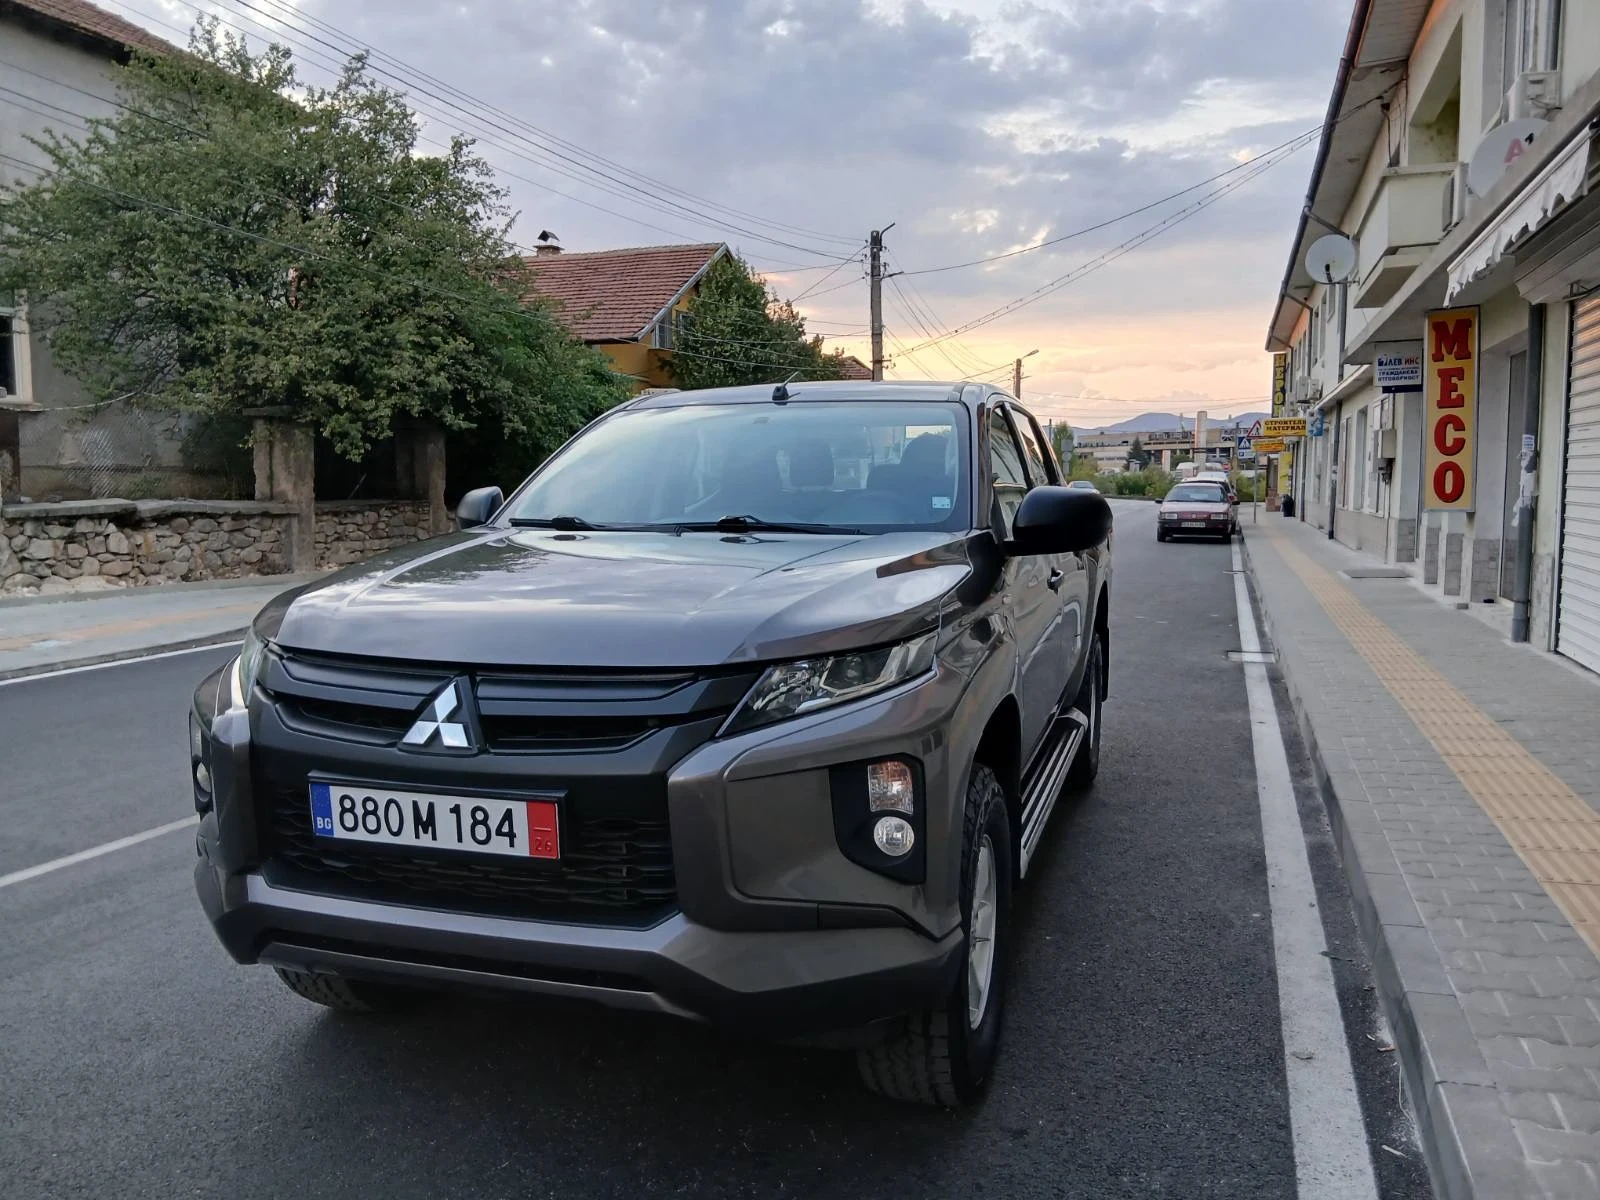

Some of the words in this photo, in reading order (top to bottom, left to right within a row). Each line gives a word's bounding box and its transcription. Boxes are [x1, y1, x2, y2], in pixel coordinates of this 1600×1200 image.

[1404, 357, 1420, 366] ИНС
[1431, 318, 1473, 504] МЕСО
[316, 816, 333, 830] BG
[338, 793, 404, 838] 880
[411, 799, 438, 842] M
[448, 803, 517, 849] 184
